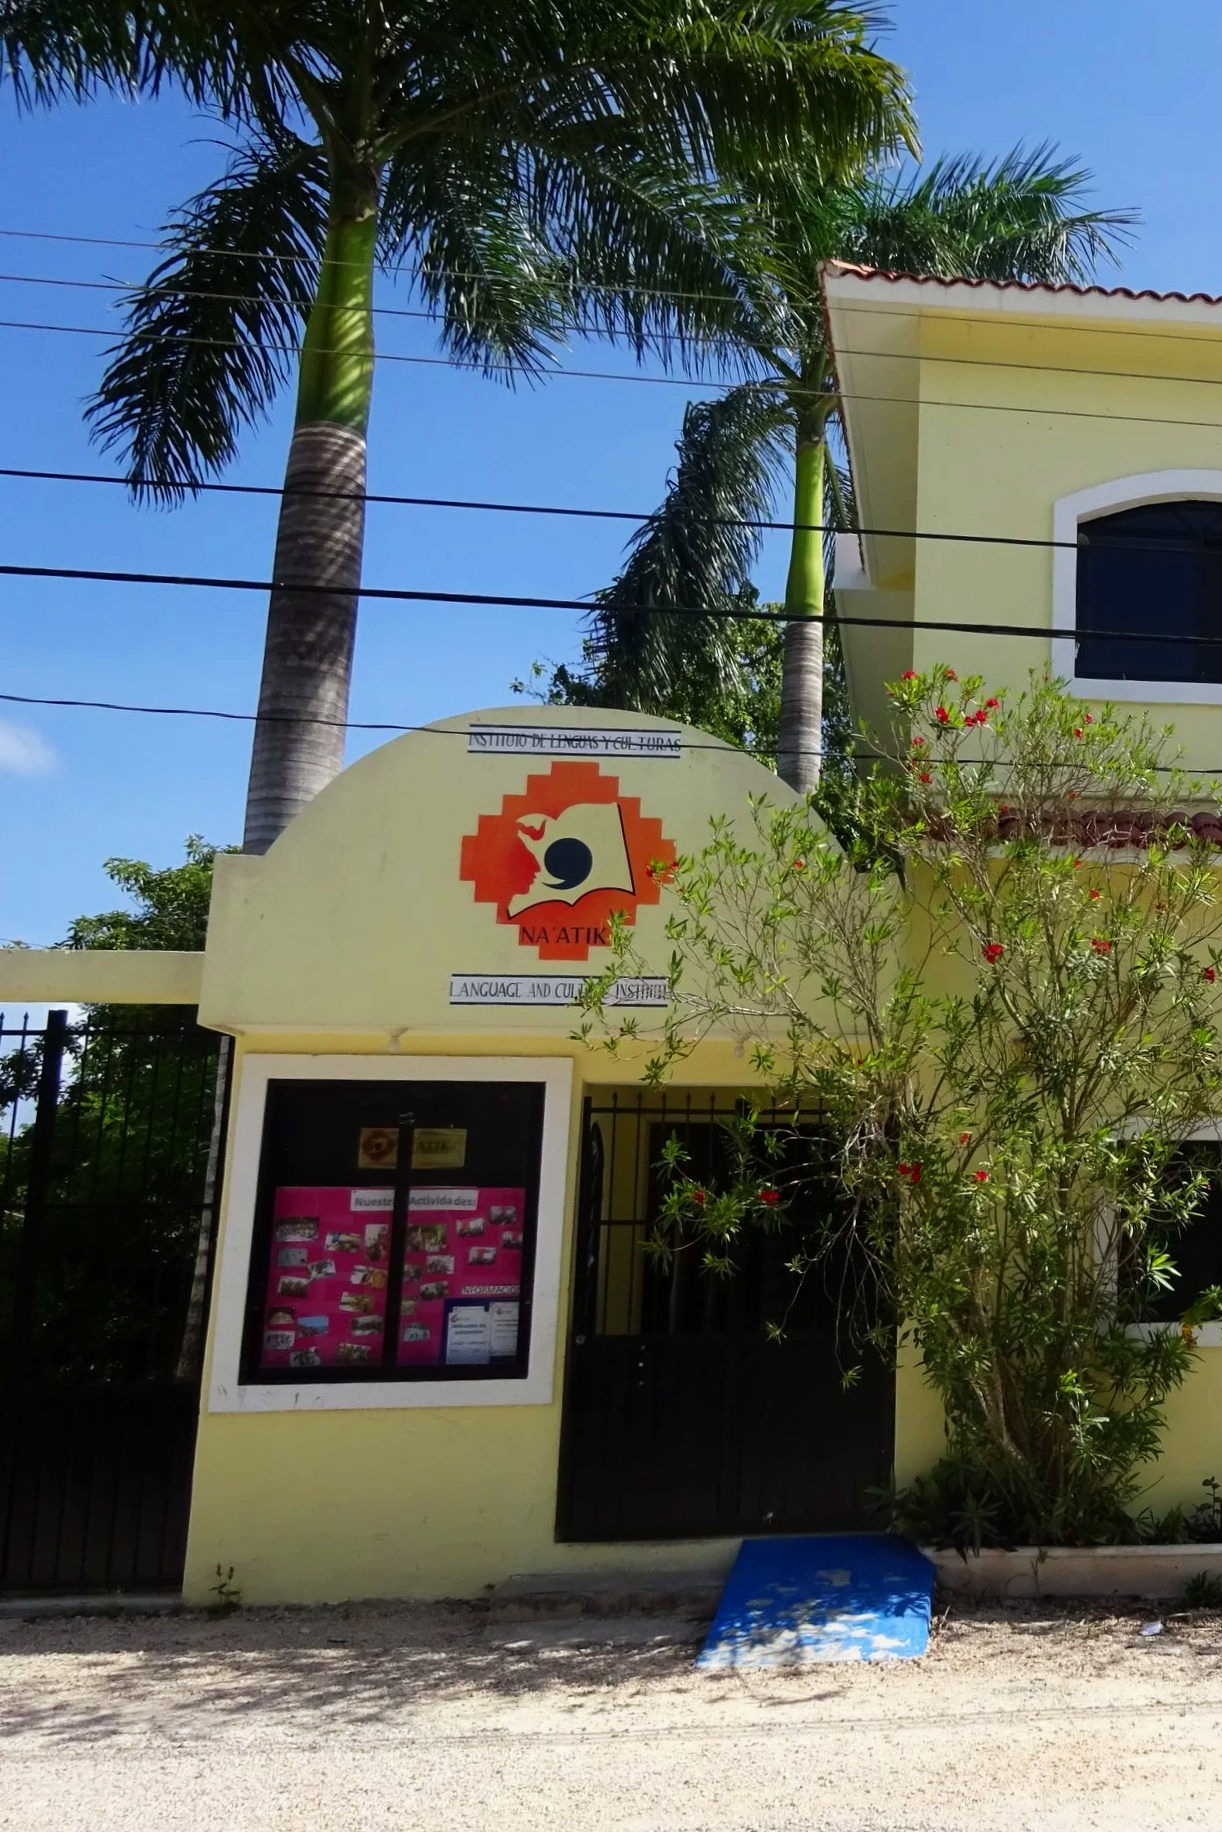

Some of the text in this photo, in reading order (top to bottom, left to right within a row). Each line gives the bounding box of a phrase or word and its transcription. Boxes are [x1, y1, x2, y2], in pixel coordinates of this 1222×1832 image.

[532, 733, 547, 748] DE
[550, 733, 599, 750] LENGUAS
[602, 735, 611, 750] Y
[613, 736, 681, 752] CULTURAS
[520, 926, 606, 944] NA'ATIK
[450, 981, 522, 998] LANGUAGE
[527, 982, 551, 998] AND
[555, 983, 608, 999] CULT
[354, 1197, 394, 1207] Nuestr
